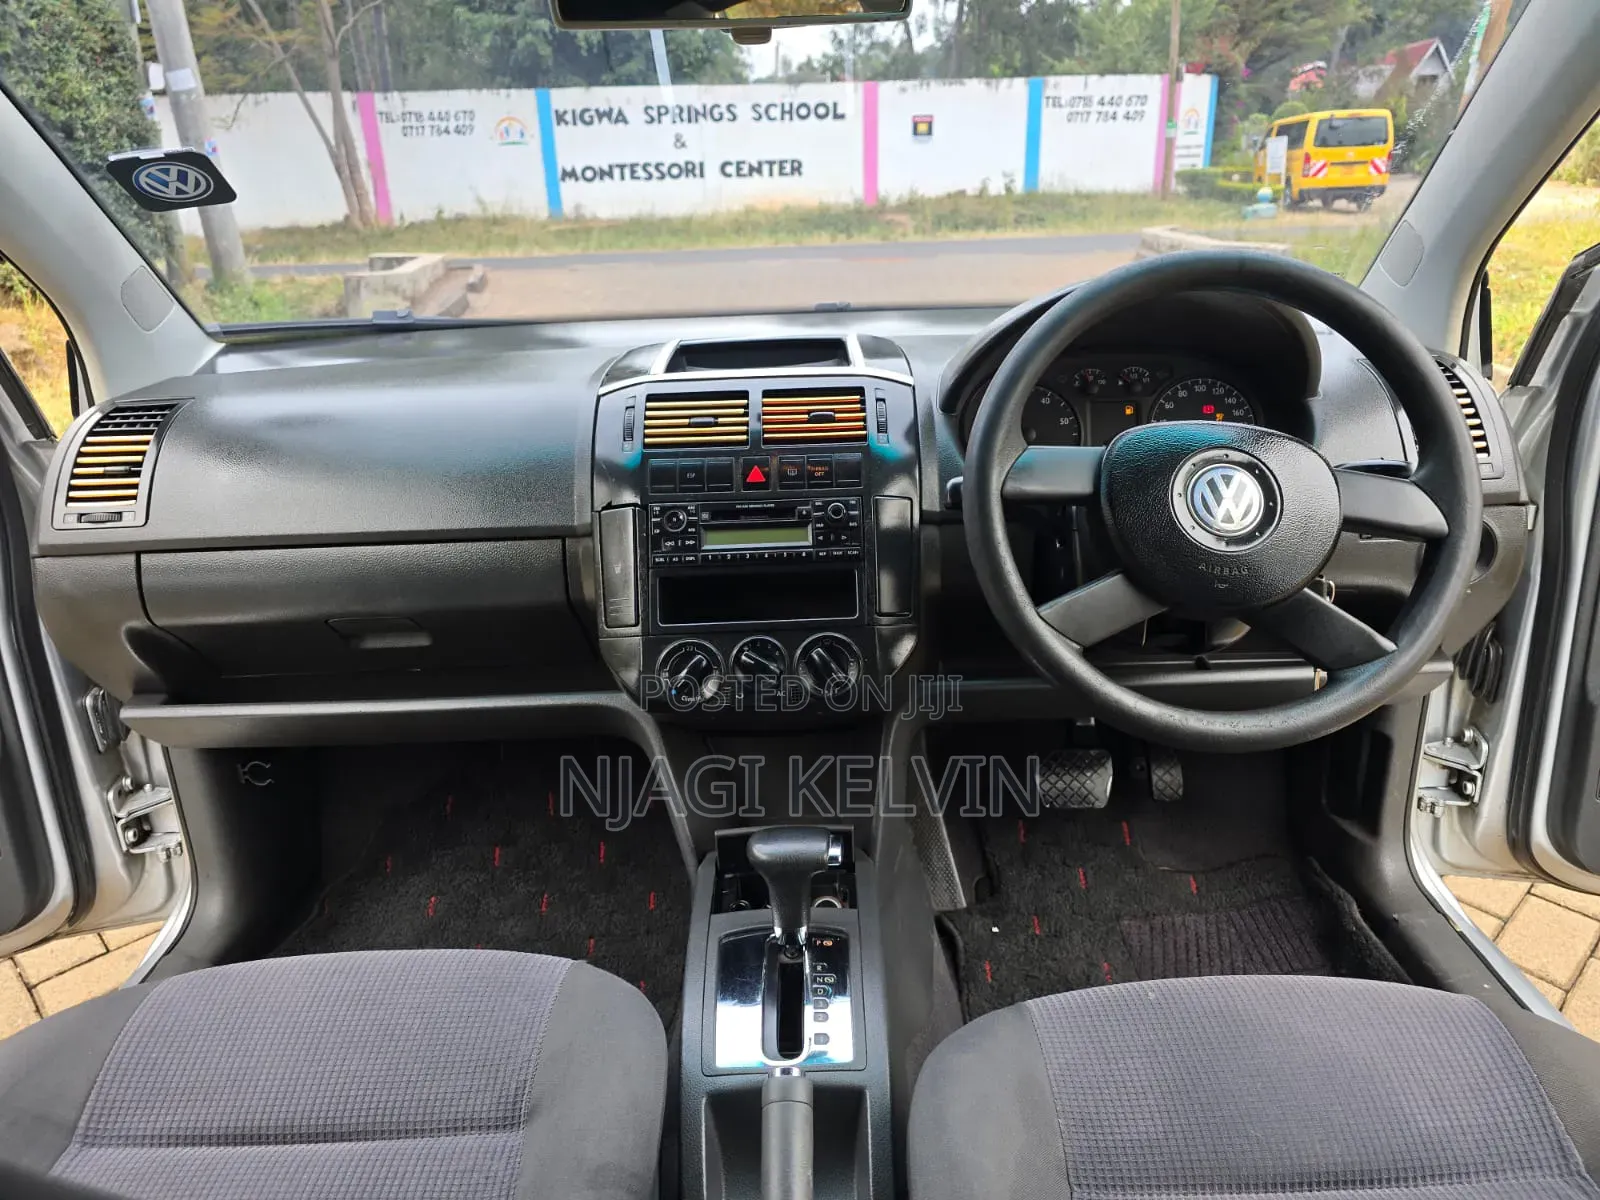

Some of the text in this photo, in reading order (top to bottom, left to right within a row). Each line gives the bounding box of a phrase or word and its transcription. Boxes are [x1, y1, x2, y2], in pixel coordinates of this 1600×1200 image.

[1125, 94, 1149, 107] 670
[554, 101, 846, 127] KIGWA SPRINGS SCHOOL
[673, 132, 688, 150] &
[560, 159, 804, 183] MONTESSORI CENTER
[1194, 384, 1207, 393] 100
[1212, 387, 1225, 396] 120
[1178, 389, 1188, 398] 80
[1040, 396, 1050, 405] 40
[1224, 396, 1237, 405] 140
[1164, 401, 1174, 410] 60
[1232, 409, 1245, 417] 160
[1059, 418, 1069, 426] 50
[1198, 562, 1250, 575] AIRBAG
